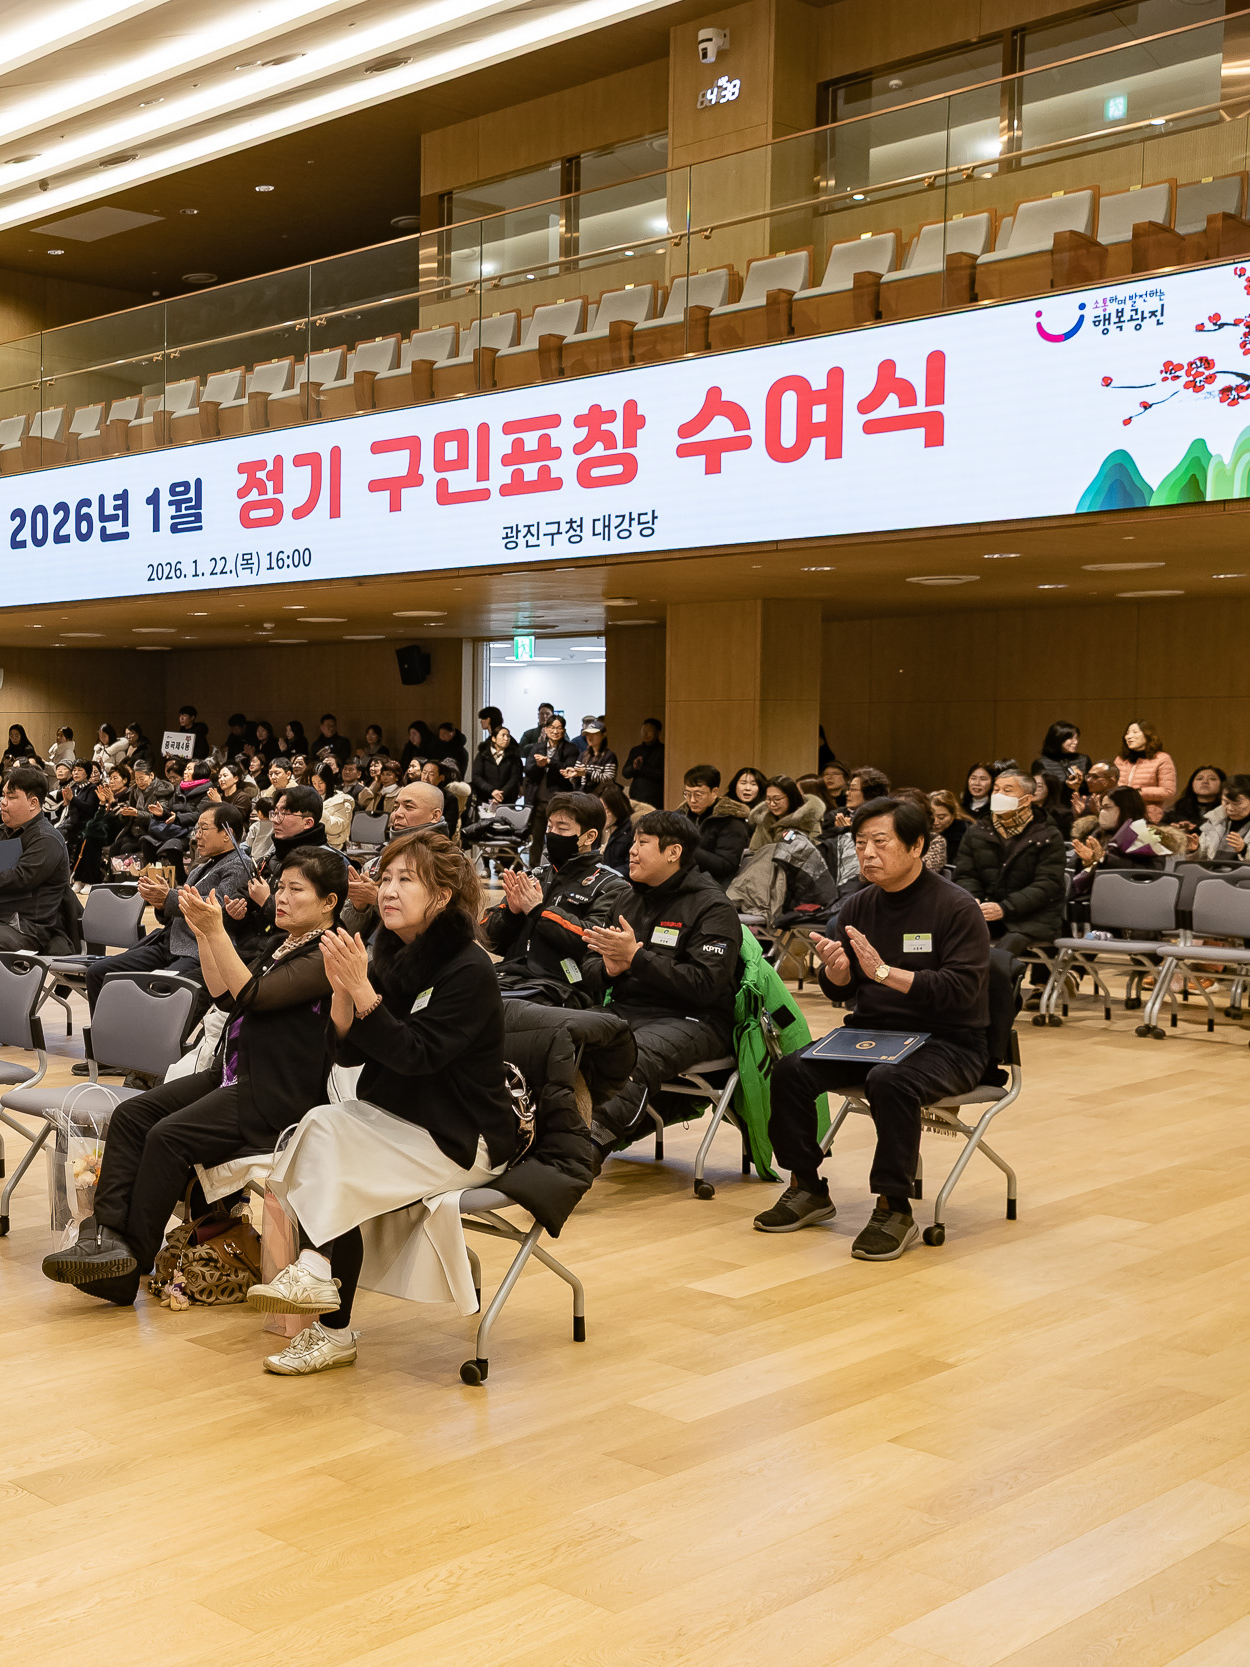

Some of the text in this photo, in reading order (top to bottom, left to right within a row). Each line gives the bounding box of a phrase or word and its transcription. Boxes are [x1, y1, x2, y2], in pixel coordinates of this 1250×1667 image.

[1092, 288, 1165, 312] 소통하며 발전하는
[1092, 303, 1165, 335] 행복광진
[9, 348, 947, 550] 2026년 1월 정기 구민표창 수여식
[501, 509, 659, 551] 광진구청 대강당
[146, 547, 313, 582] 2026. 1. 22.(목) 16:00
[702, 944, 724, 955] KPTU
